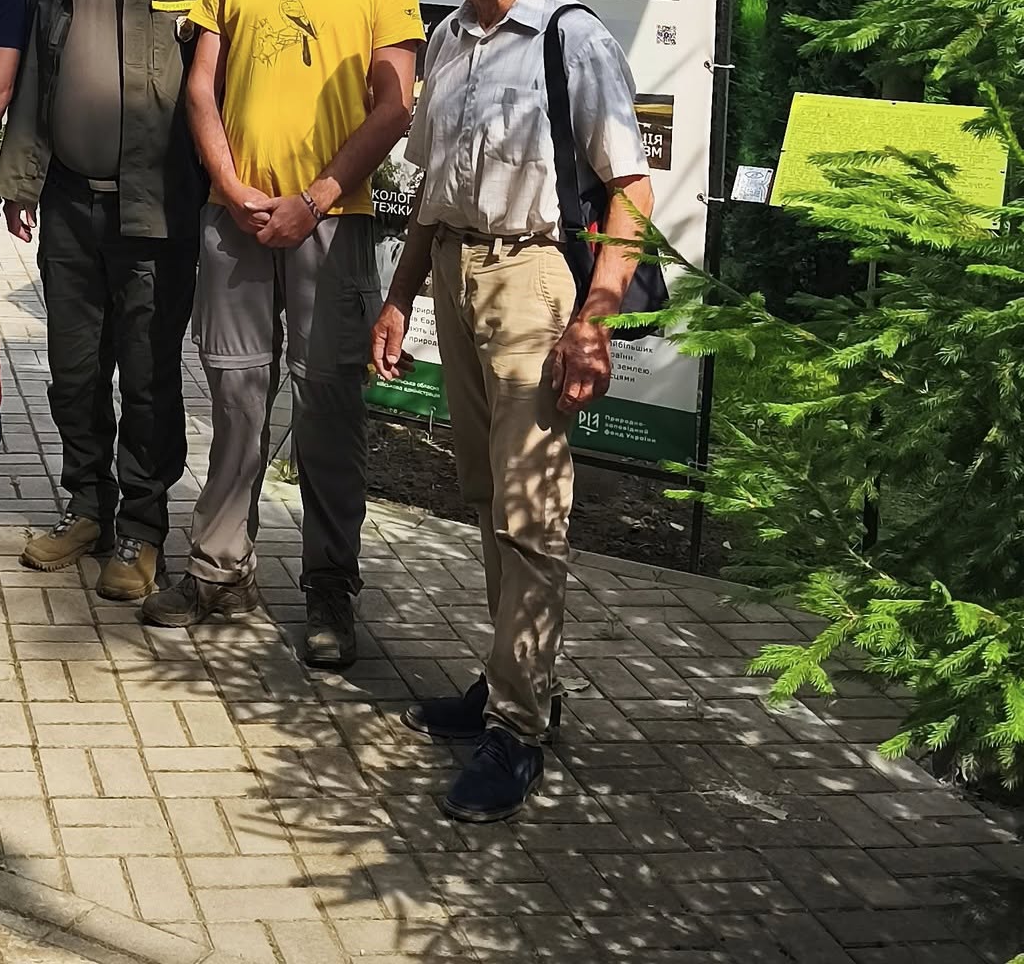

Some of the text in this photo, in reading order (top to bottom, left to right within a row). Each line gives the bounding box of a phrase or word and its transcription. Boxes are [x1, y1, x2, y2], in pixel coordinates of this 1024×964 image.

[372, 189, 416, 204] КОЛОГ
[372, 200, 414, 216] ТЕЖКИ
[617, 363, 652, 376] землею.
[604, 422, 649, 435] заповідний
[626, 432, 657, 444] України
